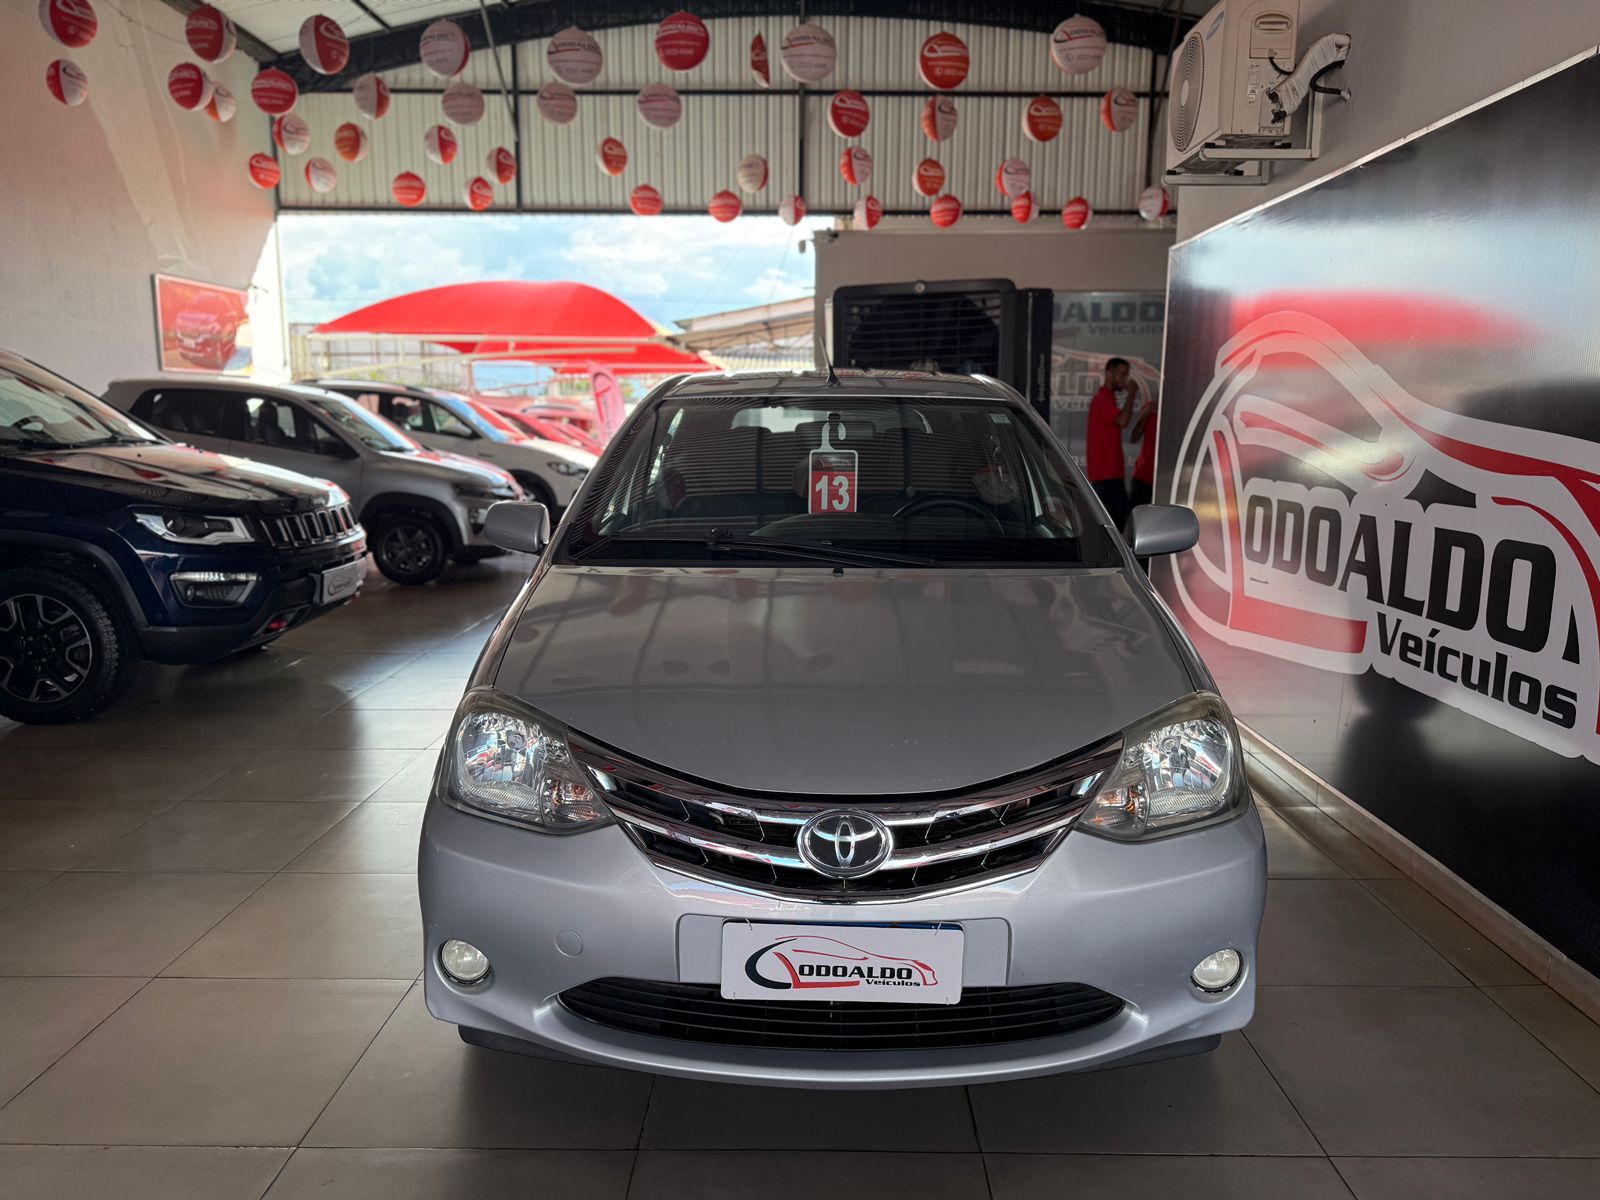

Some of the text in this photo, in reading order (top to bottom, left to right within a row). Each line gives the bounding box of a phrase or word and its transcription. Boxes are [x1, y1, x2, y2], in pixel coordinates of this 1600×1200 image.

[815, 475, 850, 511] 13
[1376, 611, 1578, 729] Veículos
[865, 979, 921, 987] Veículos
